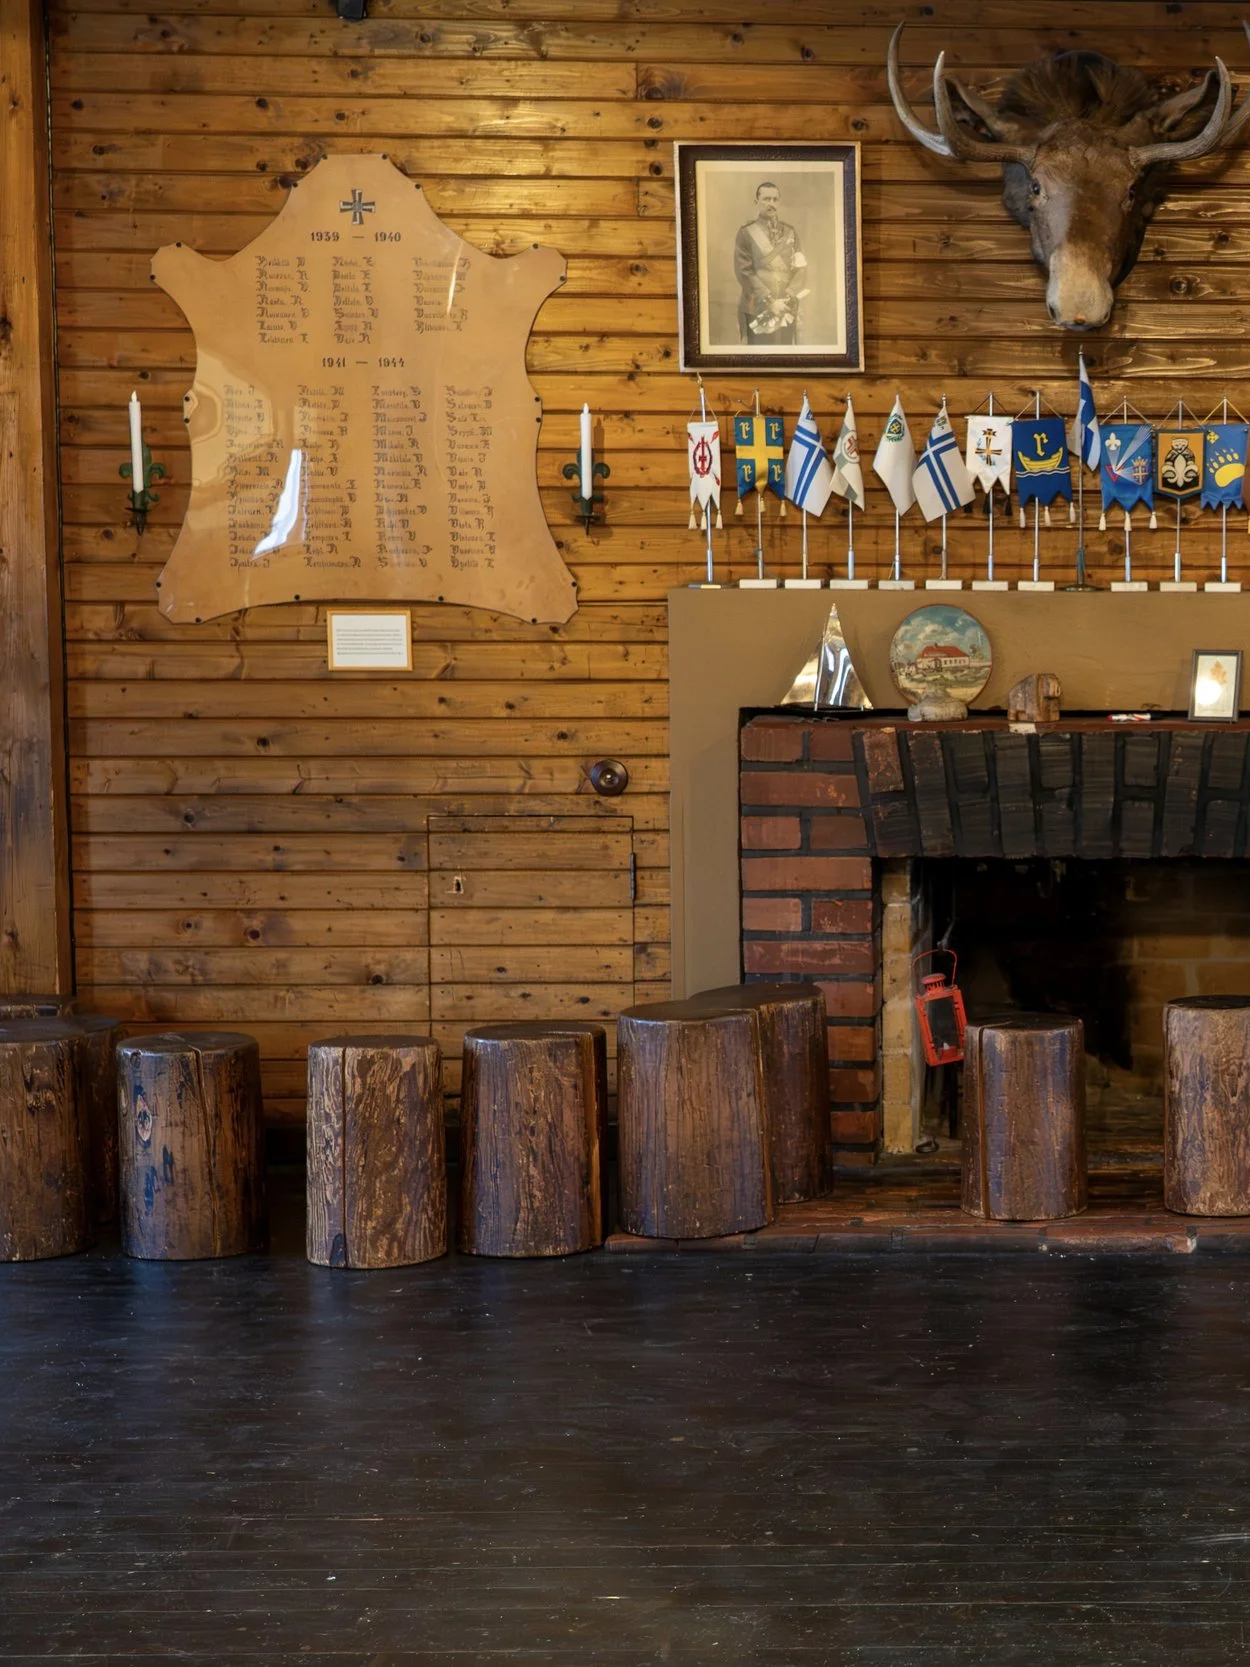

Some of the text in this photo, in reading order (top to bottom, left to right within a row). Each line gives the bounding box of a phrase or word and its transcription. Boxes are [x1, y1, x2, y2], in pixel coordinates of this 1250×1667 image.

[311, 231, 340, 242] 1939
[374, 231, 402, 242] 1940
[322, 357, 346, 368] 1941
[378, 357, 405, 368] 1944
